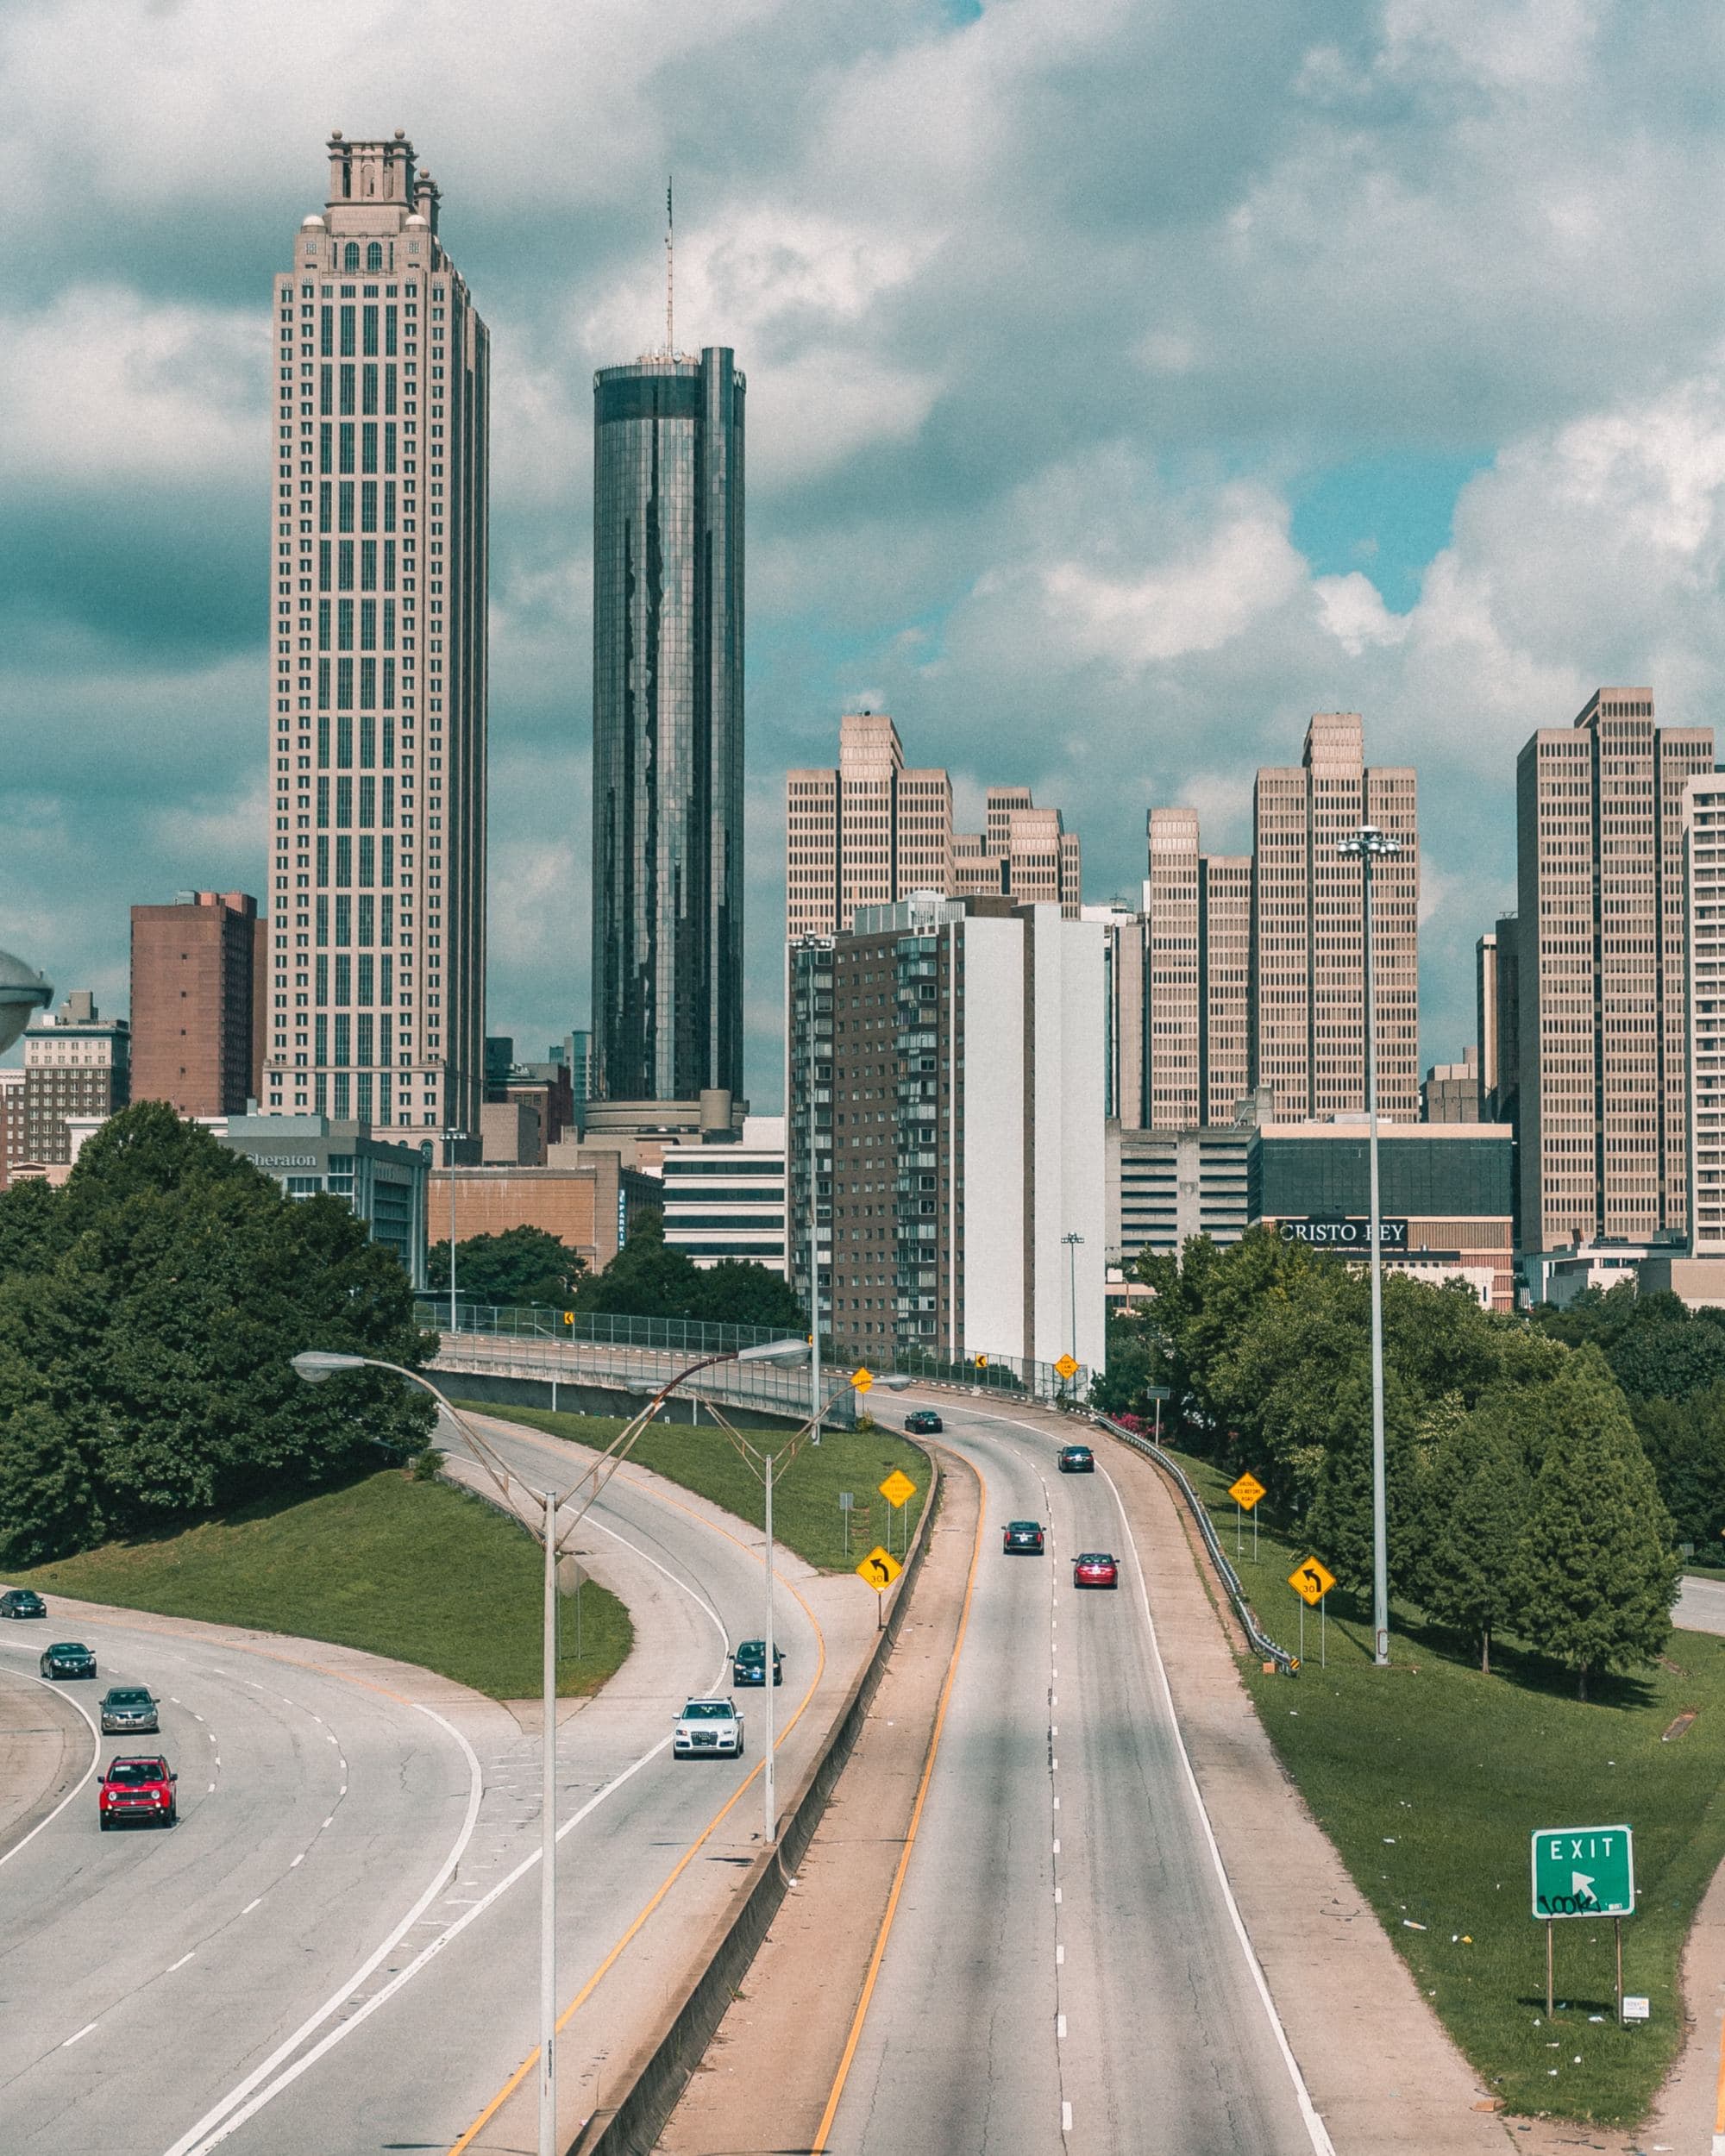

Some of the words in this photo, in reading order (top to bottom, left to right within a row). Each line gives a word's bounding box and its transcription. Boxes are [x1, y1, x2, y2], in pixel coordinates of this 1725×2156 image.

[1280, 1224, 1357, 1241] CRISTO
[871, 1575, 883, 1583] 30
[1551, 1837, 1614, 1860] EXIT
